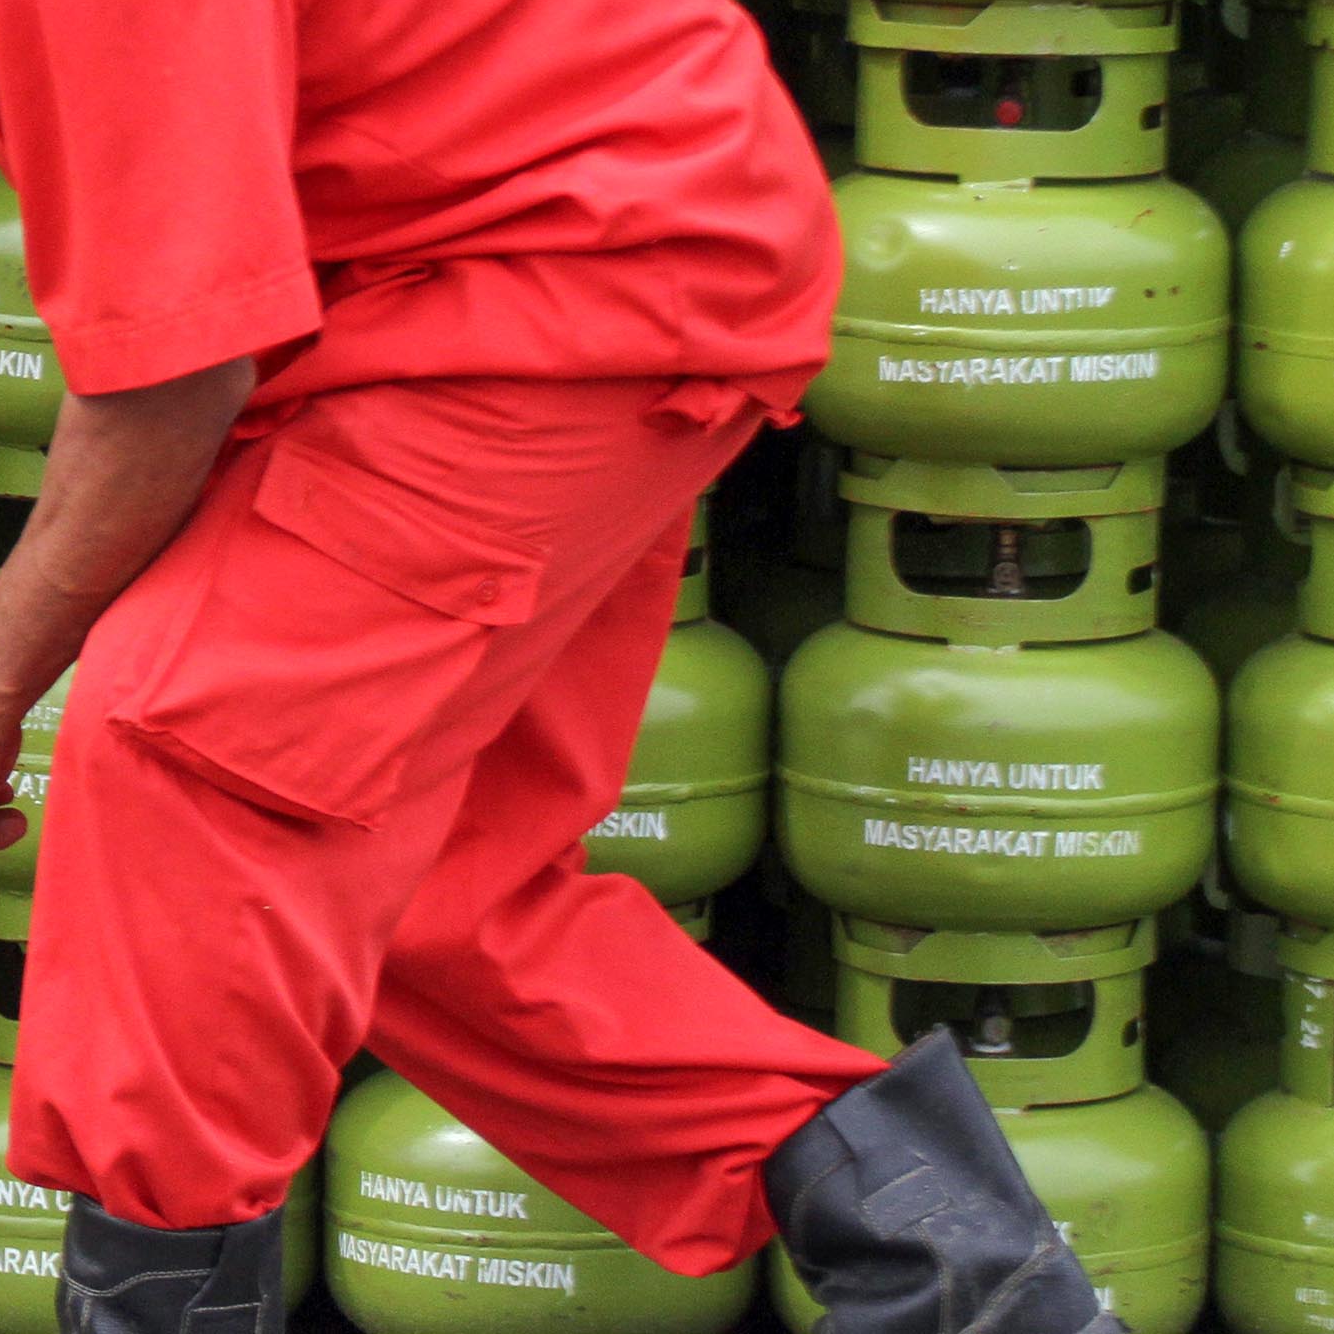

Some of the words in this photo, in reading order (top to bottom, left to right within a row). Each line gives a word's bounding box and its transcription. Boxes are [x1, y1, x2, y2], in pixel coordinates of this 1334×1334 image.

[920, 288, 1017, 315] HANYA
[1020, 286, 1115, 315] UNTUK
[878, 355, 1067, 385] MASYARAKAT
[1069, 352, 1158, 382] MISKIN
[908, 757, 1004, 789] HANYA
[1008, 763, 1103, 791] UNTUK
[589, 811, 668, 842] ISKIN
[864, 818, 1052, 858] MASYARAKAT
[1054, 830, 1139, 857] MISKIN
[360, 1171, 432, 1209] HANYA
[434, 1185, 528, 1219] UNTUK
[338, 1232, 474, 1281] MASYARAKAT
[477, 1257, 575, 1294] MISKIN
